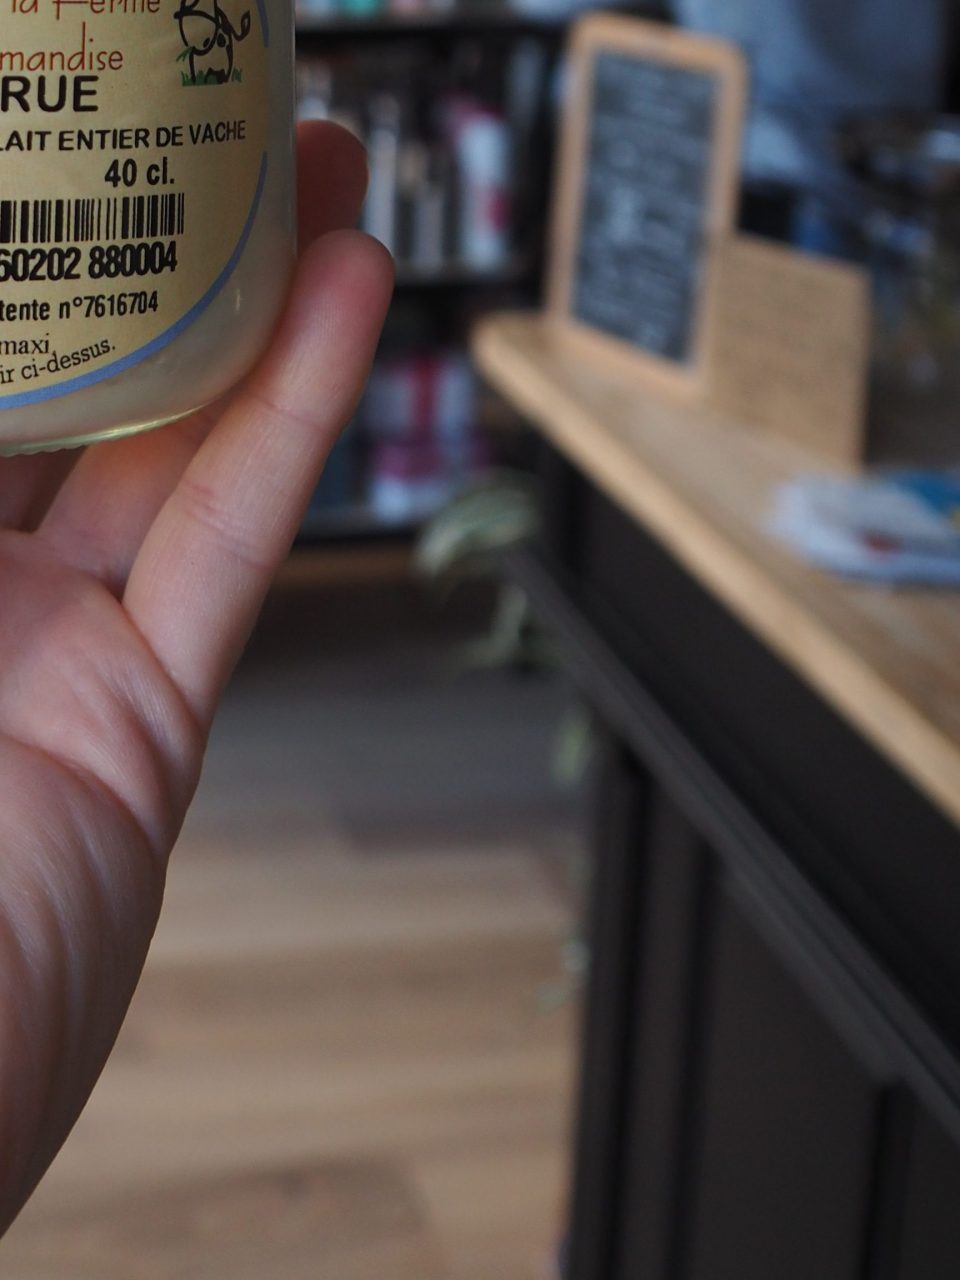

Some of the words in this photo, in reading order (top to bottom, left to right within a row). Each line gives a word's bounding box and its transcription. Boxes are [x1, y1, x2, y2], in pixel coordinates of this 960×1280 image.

[58, 128, 151, 152] ENTIER
[155, 126, 184, 148] DE
[189, 120, 246, 145] VACHE
[104, 158, 138, 188] 40
[146, 156, 175, 186] cl.
[88, 241, 177, 278] 880004
[20, 338, 116, 380] ci-dessus.
